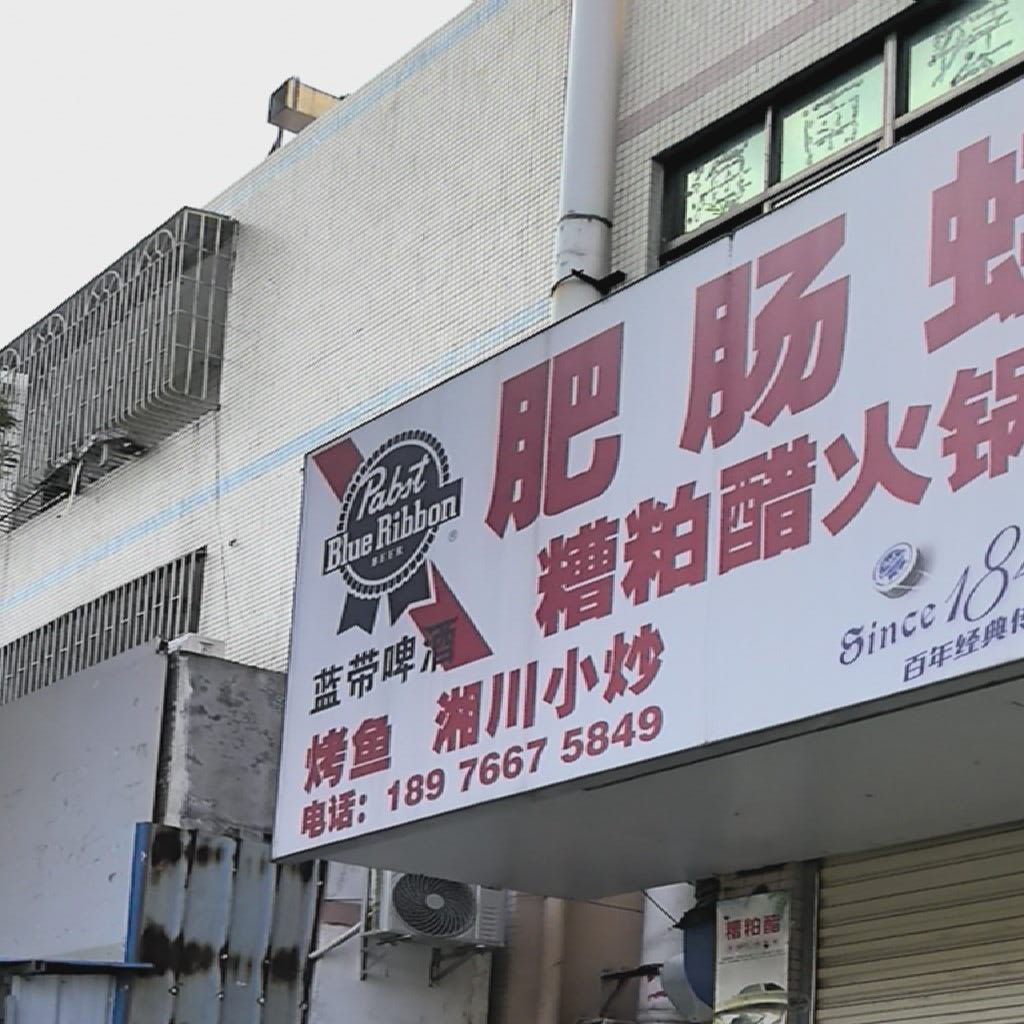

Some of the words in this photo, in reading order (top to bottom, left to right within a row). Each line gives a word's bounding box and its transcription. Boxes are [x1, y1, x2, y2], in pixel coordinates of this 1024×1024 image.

[356, 453, 431, 521] Pabst
[325, 531, 374, 573] Blue
[375, 495, 457, 551] Ribbon
[309, 617, 457, 715] 蓝带啤酒
[839, 603, 936, 665] Since
[304, 714, 393, 794] 烤鱼
[432, 623, 665, 754] 湘川小炒
[387, 768, 446, 812] 189
[458, 738, 548, 793] 7667
[561, 705, 664, 764] 5849
